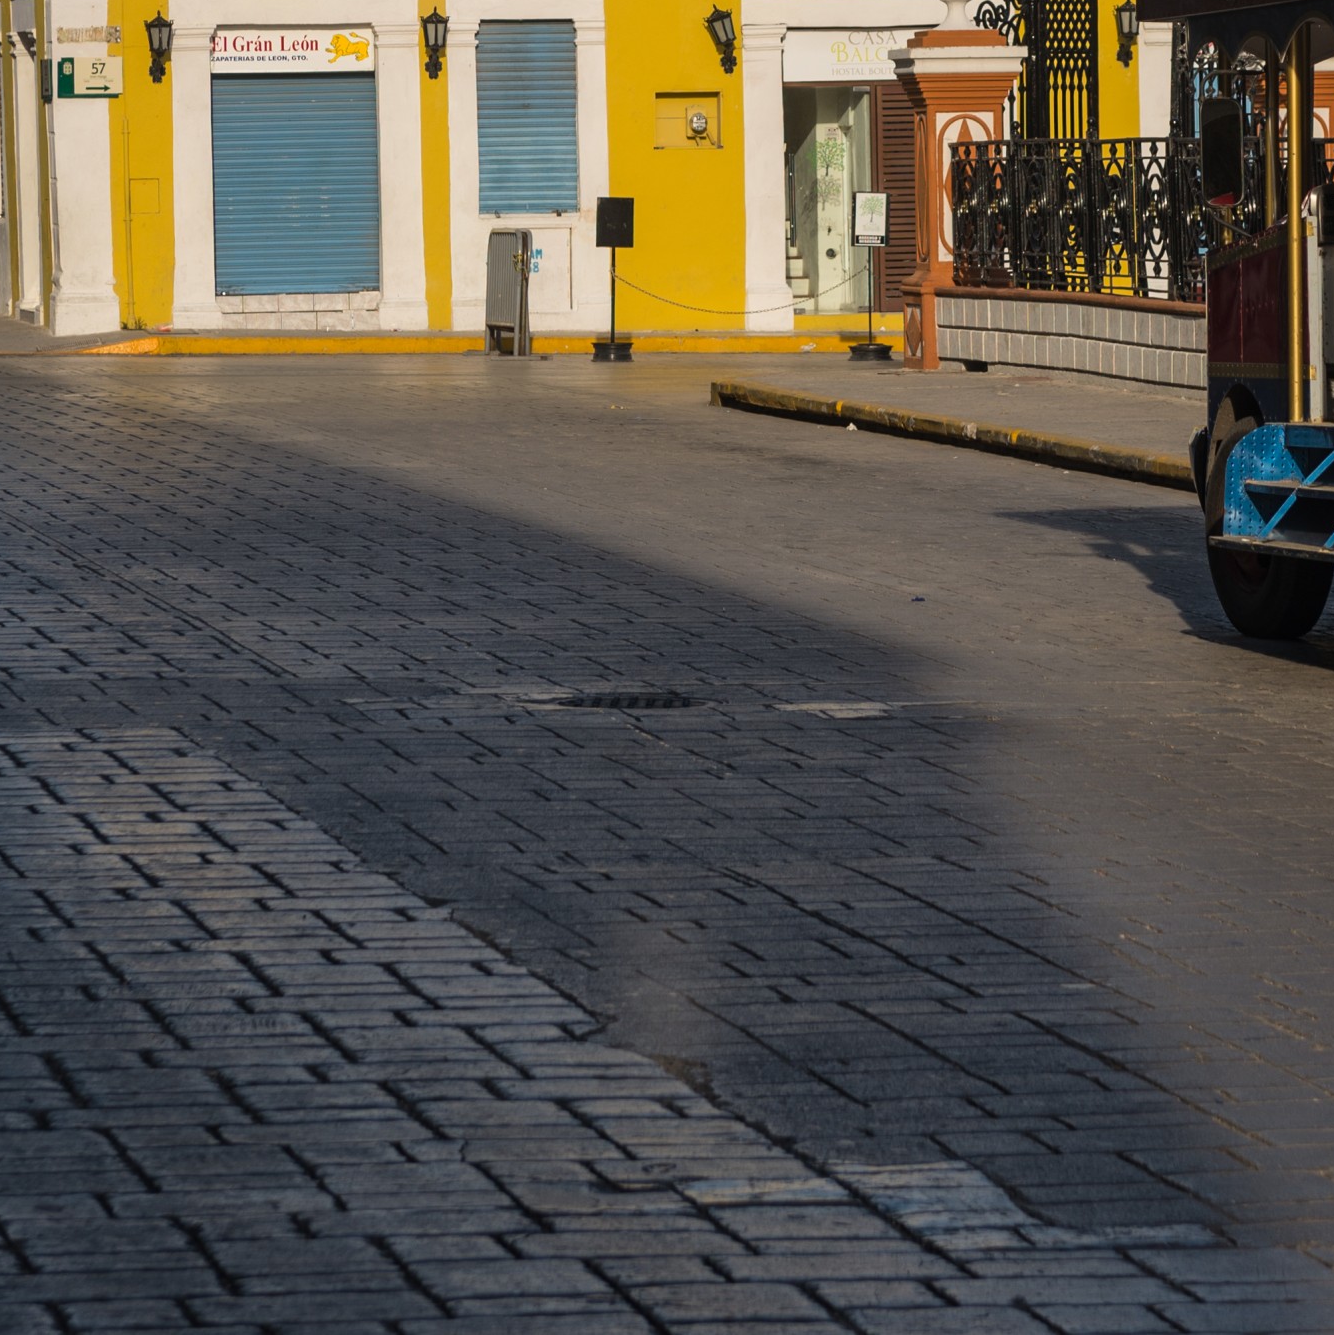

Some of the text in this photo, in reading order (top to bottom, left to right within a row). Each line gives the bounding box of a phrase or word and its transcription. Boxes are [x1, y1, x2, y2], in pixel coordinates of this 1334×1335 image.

[212, 34, 319, 52] El Grán León
[848, 30, 897, 45] CASA
[831, 41, 889, 63] BALC
[91, 63, 106, 75] 57
[832, 67, 893, 76] HOSTAL BOUT
